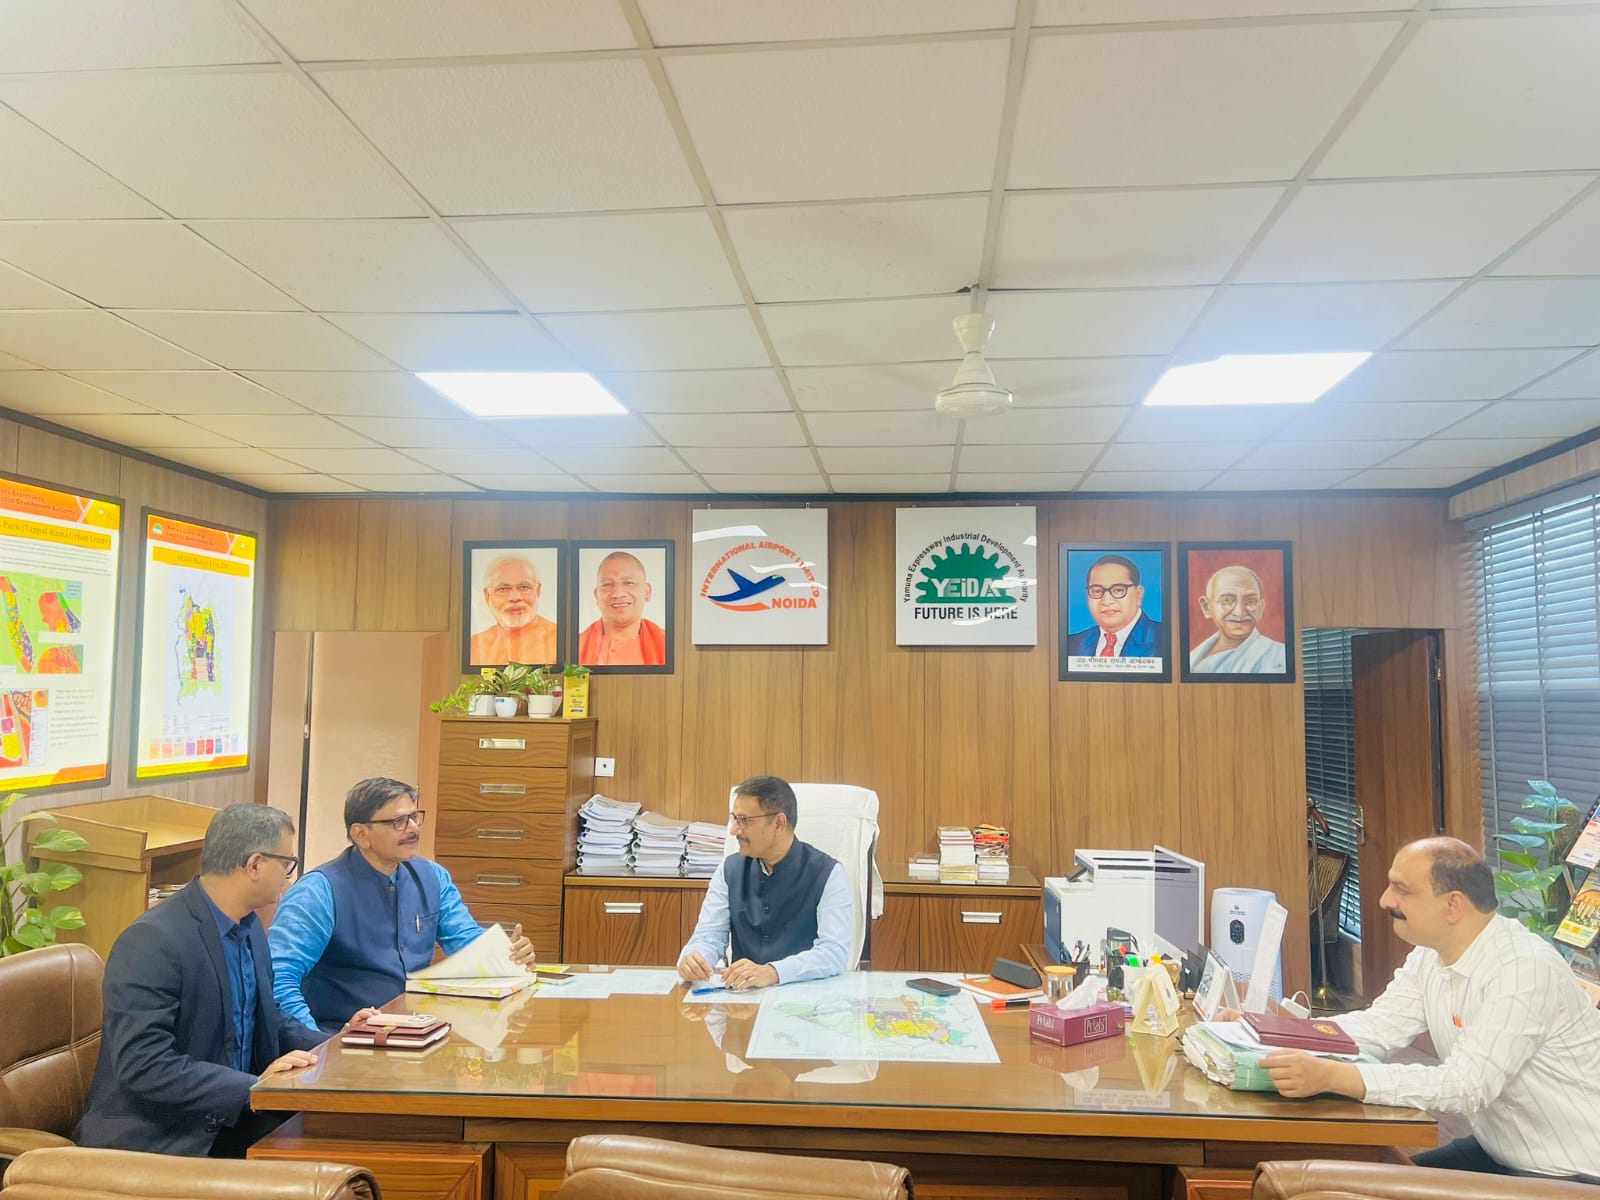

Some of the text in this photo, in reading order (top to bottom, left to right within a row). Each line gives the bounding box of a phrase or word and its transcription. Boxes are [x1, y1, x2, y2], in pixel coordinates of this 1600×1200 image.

[943, 532, 980, 543] Industrial
[980, 534, 1021, 569] Development
[700, 541, 757, 598] INTERNATIONAL
[758, 541, 797, 560] AIRPORT
[908, 539, 944, 573] Expressway
[771, 597, 818, 609] NOIDA
[904, 572, 914, 604] Yamuna
[914, 607, 964, 620] FUTURE
[967, 606, 981, 619] IS
